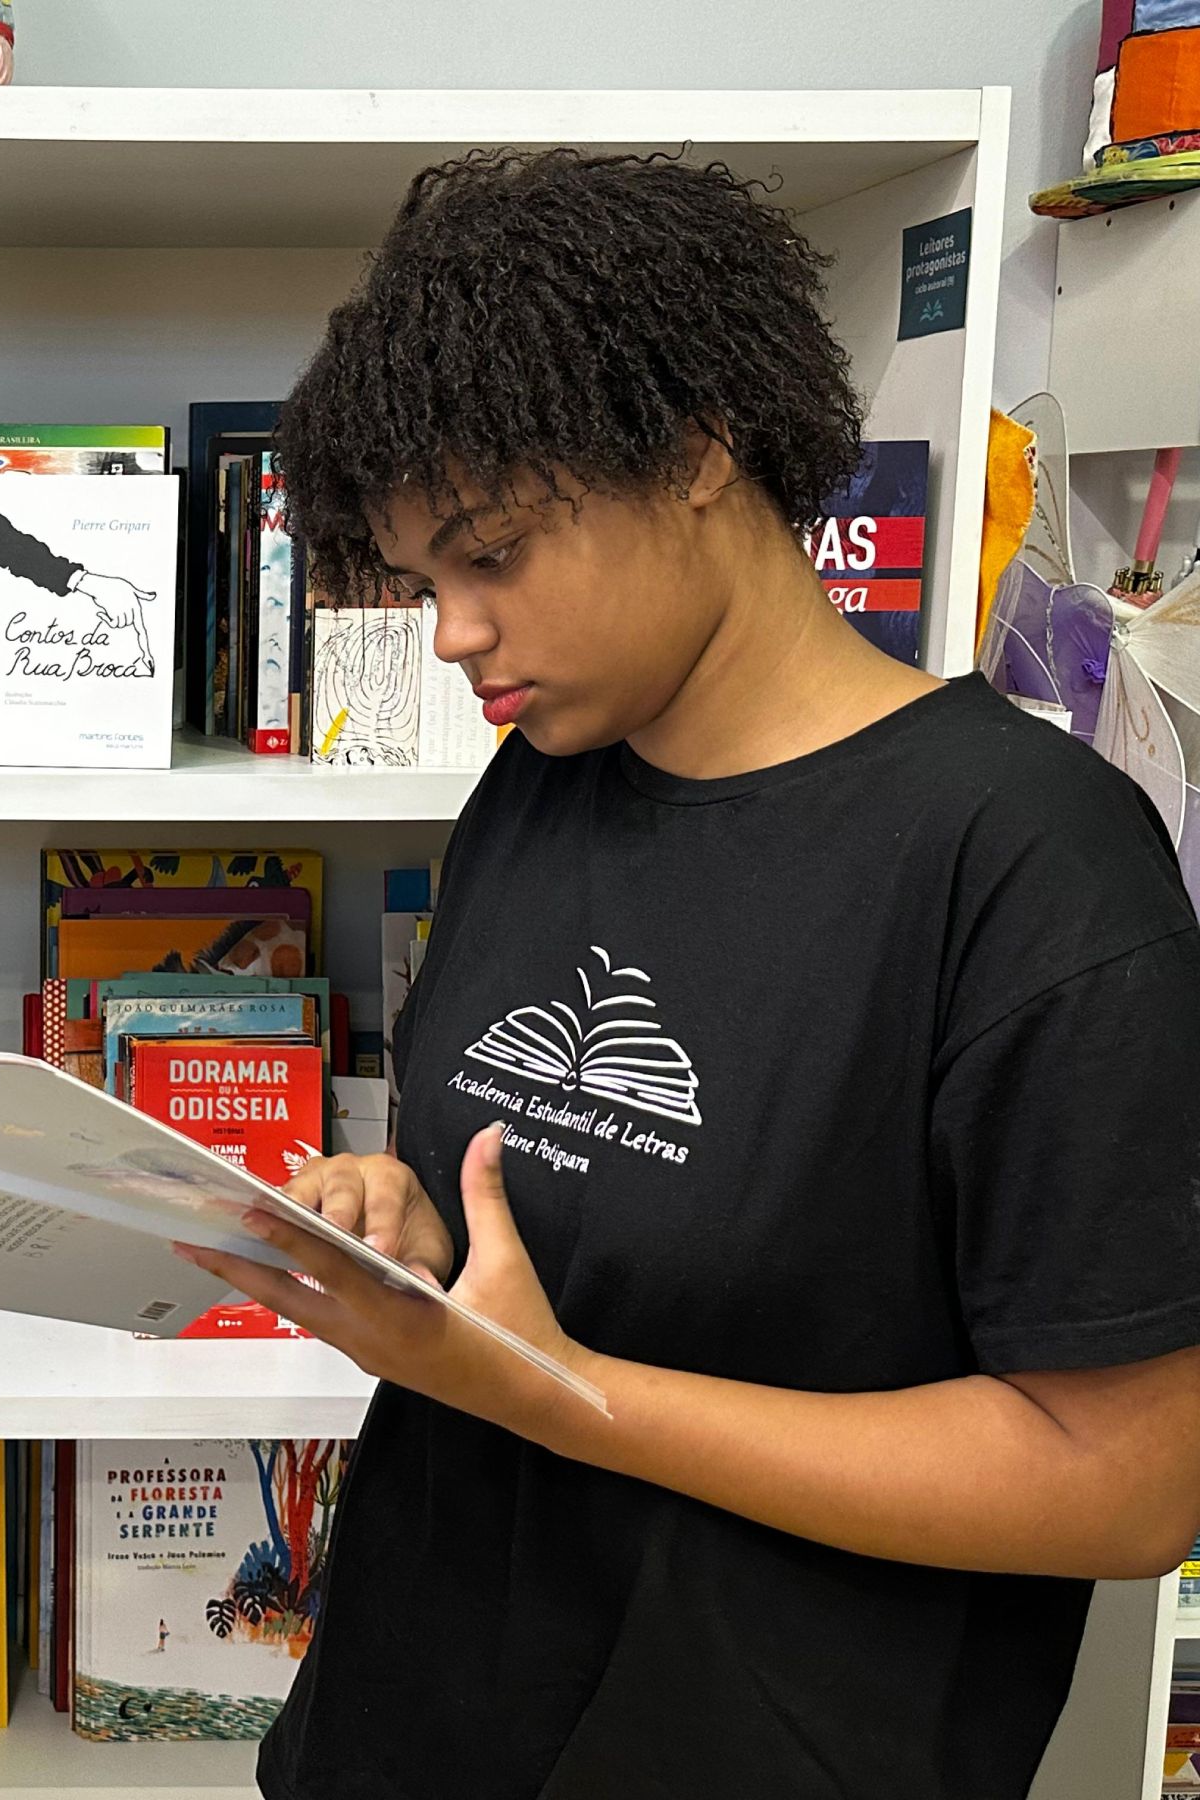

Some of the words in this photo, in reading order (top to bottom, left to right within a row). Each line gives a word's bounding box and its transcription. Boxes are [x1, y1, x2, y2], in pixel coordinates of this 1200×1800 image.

[920, 235, 954, 256] Leitores
[906, 251, 966, 283] protagonistas
[72, 519, 105, 531] Pierre
[109, 519, 151, 533] Gripari
[803, 516, 877, 571] AS
[5, 612, 77, 645] Contos
[81, 621, 110, 646] da
[6, 646, 66, 676] Rua
[117, 1003, 153, 1013] JOÃO
[159, 1003, 243, 1013] GUIMARÃES
[250, 1003, 286, 1013] ROSA
[169, 1059, 288, 1083] DORAMAR
[233, 1086, 239, 1095] A
[169, 1097, 289, 1121] ODISSEIA
[447, 1070, 522, 1113] Academia
[525, 1095, 598, 1134] Estudantil
[593, 1113, 619, 1140] de
[620, 1122, 689, 1164] Letras
[535, 1138, 590, 1173] Potiguara
[108, 1468, 226, 1484] PROFESSORA
[130, 1486, 223, 1502] FLORESTA
[142, 1504, 217, 1521] GRANDE
[120, 1522, 215, 1539] SERPENTE
